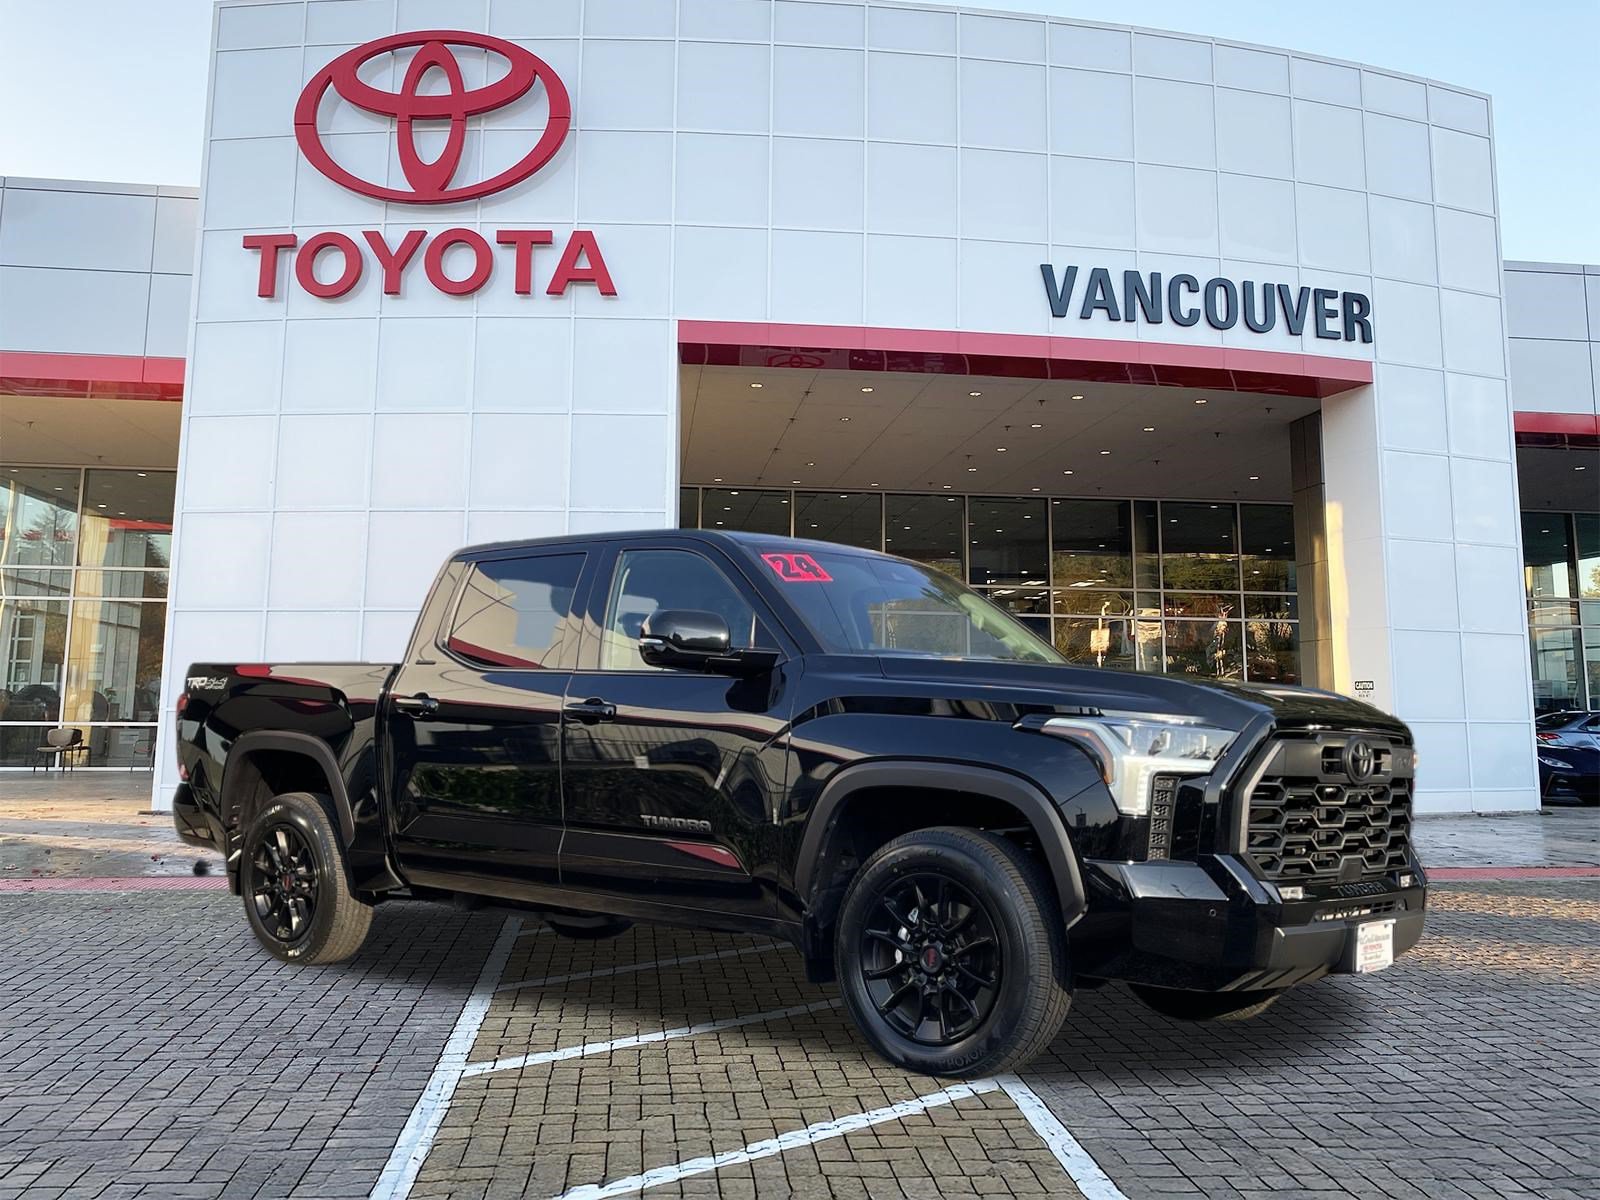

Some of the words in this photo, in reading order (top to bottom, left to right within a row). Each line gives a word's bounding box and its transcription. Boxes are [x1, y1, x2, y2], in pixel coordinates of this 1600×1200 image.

[242, 227, 618, 298] TOYOTA
[1040, 263, 1374, 344] VANCOUVER
[640, 814, 712, 832] TUNDRA
